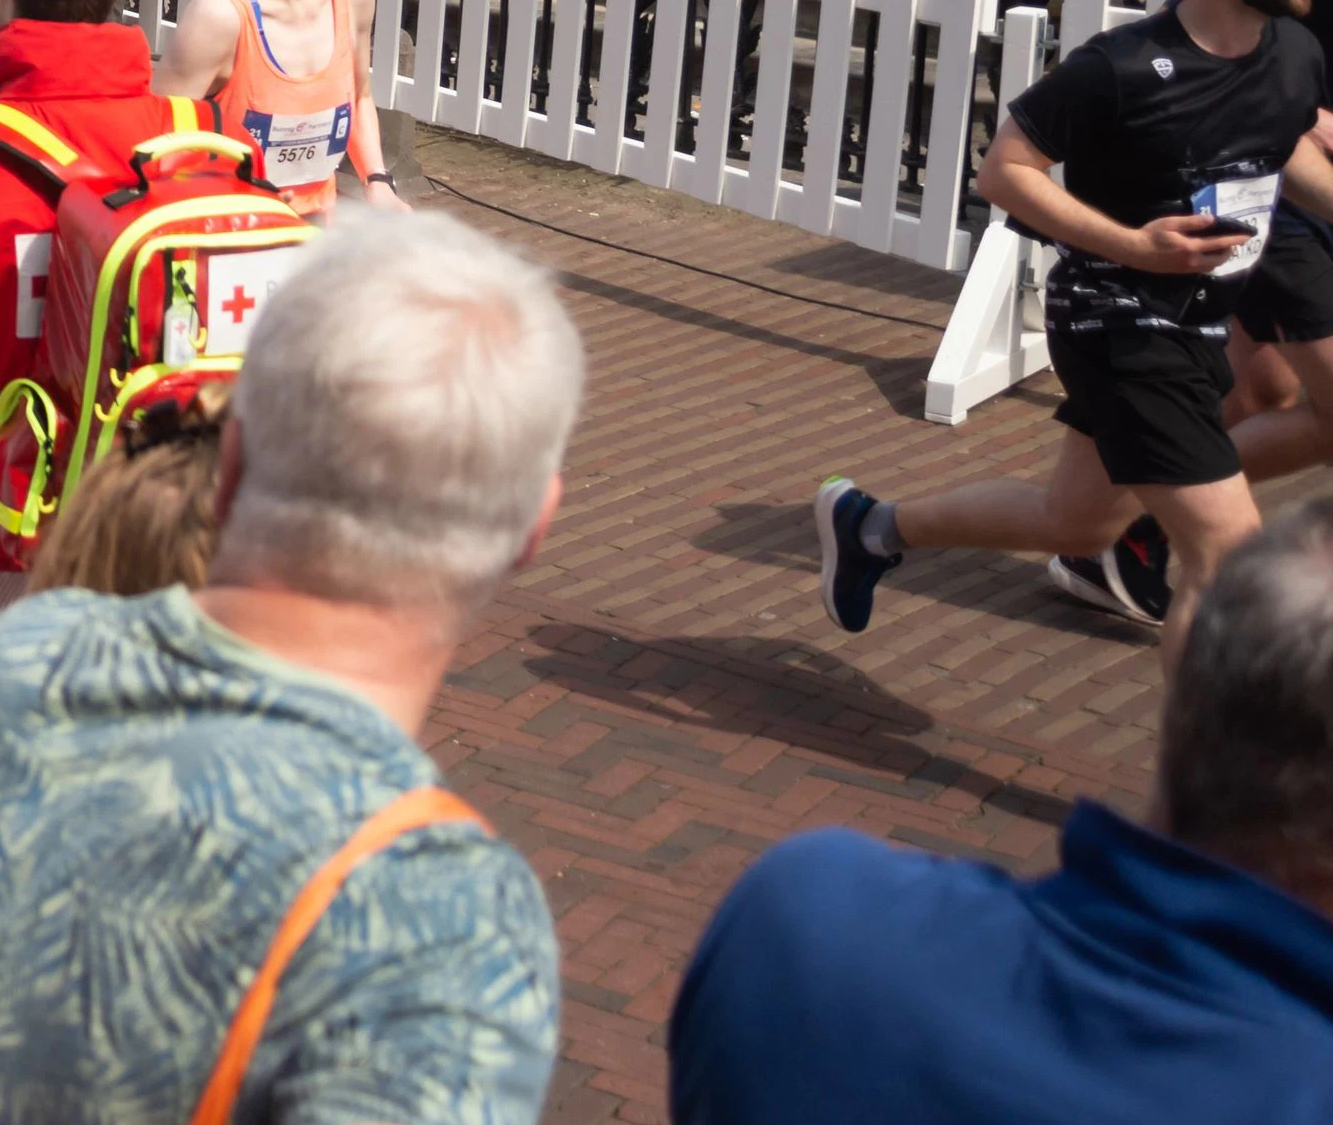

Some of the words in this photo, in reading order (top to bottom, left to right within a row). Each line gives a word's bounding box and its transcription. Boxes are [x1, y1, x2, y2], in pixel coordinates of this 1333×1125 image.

[250, 128, 261, 137] 21
[338, 125, 345, 135] C
[277, 145, 316, 163] 5576
